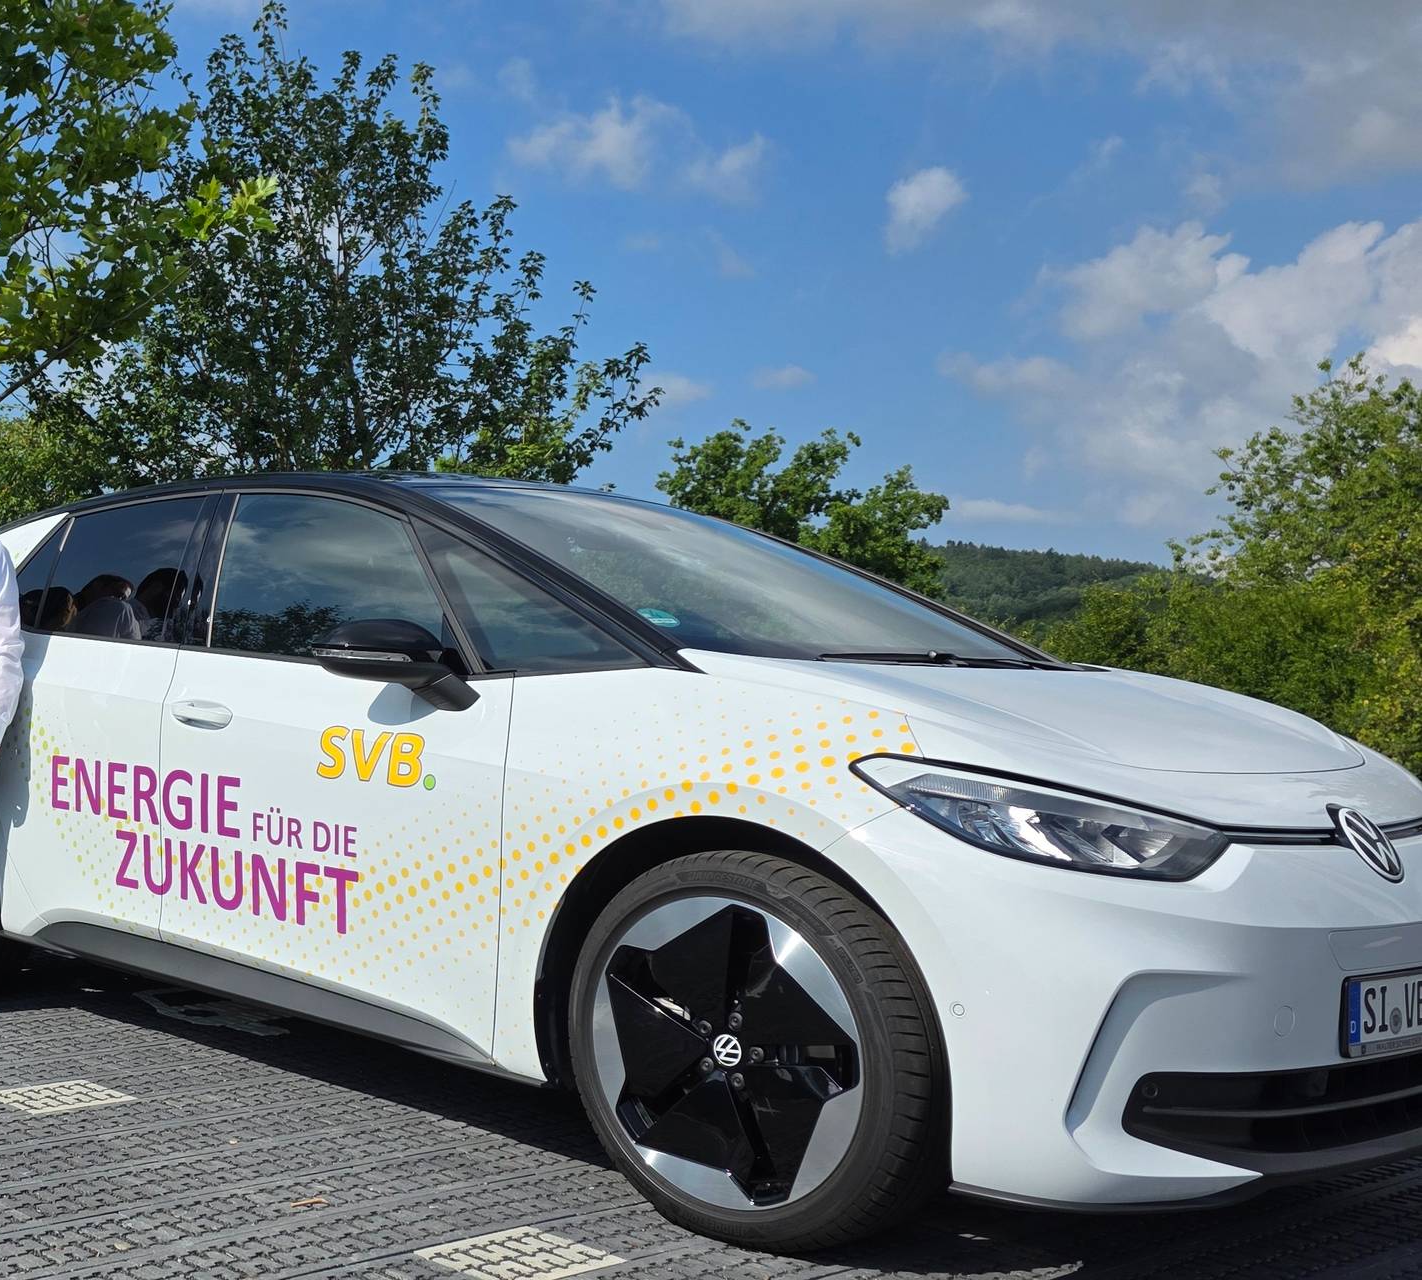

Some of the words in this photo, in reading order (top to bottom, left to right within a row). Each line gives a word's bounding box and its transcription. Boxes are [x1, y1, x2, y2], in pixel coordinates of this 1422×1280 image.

[317, 726, 437, 791] SVB.
[51, 754, 242, 838] ENERGIE
[251, 806, 304, 850] FÜR
[313, 820, 358, 857] DIE
[116, 829, 360, 935] ZUKUNFT
[1350, 1020, 1357, 1034] D
[1363, 985, 1389, 1034] SI
